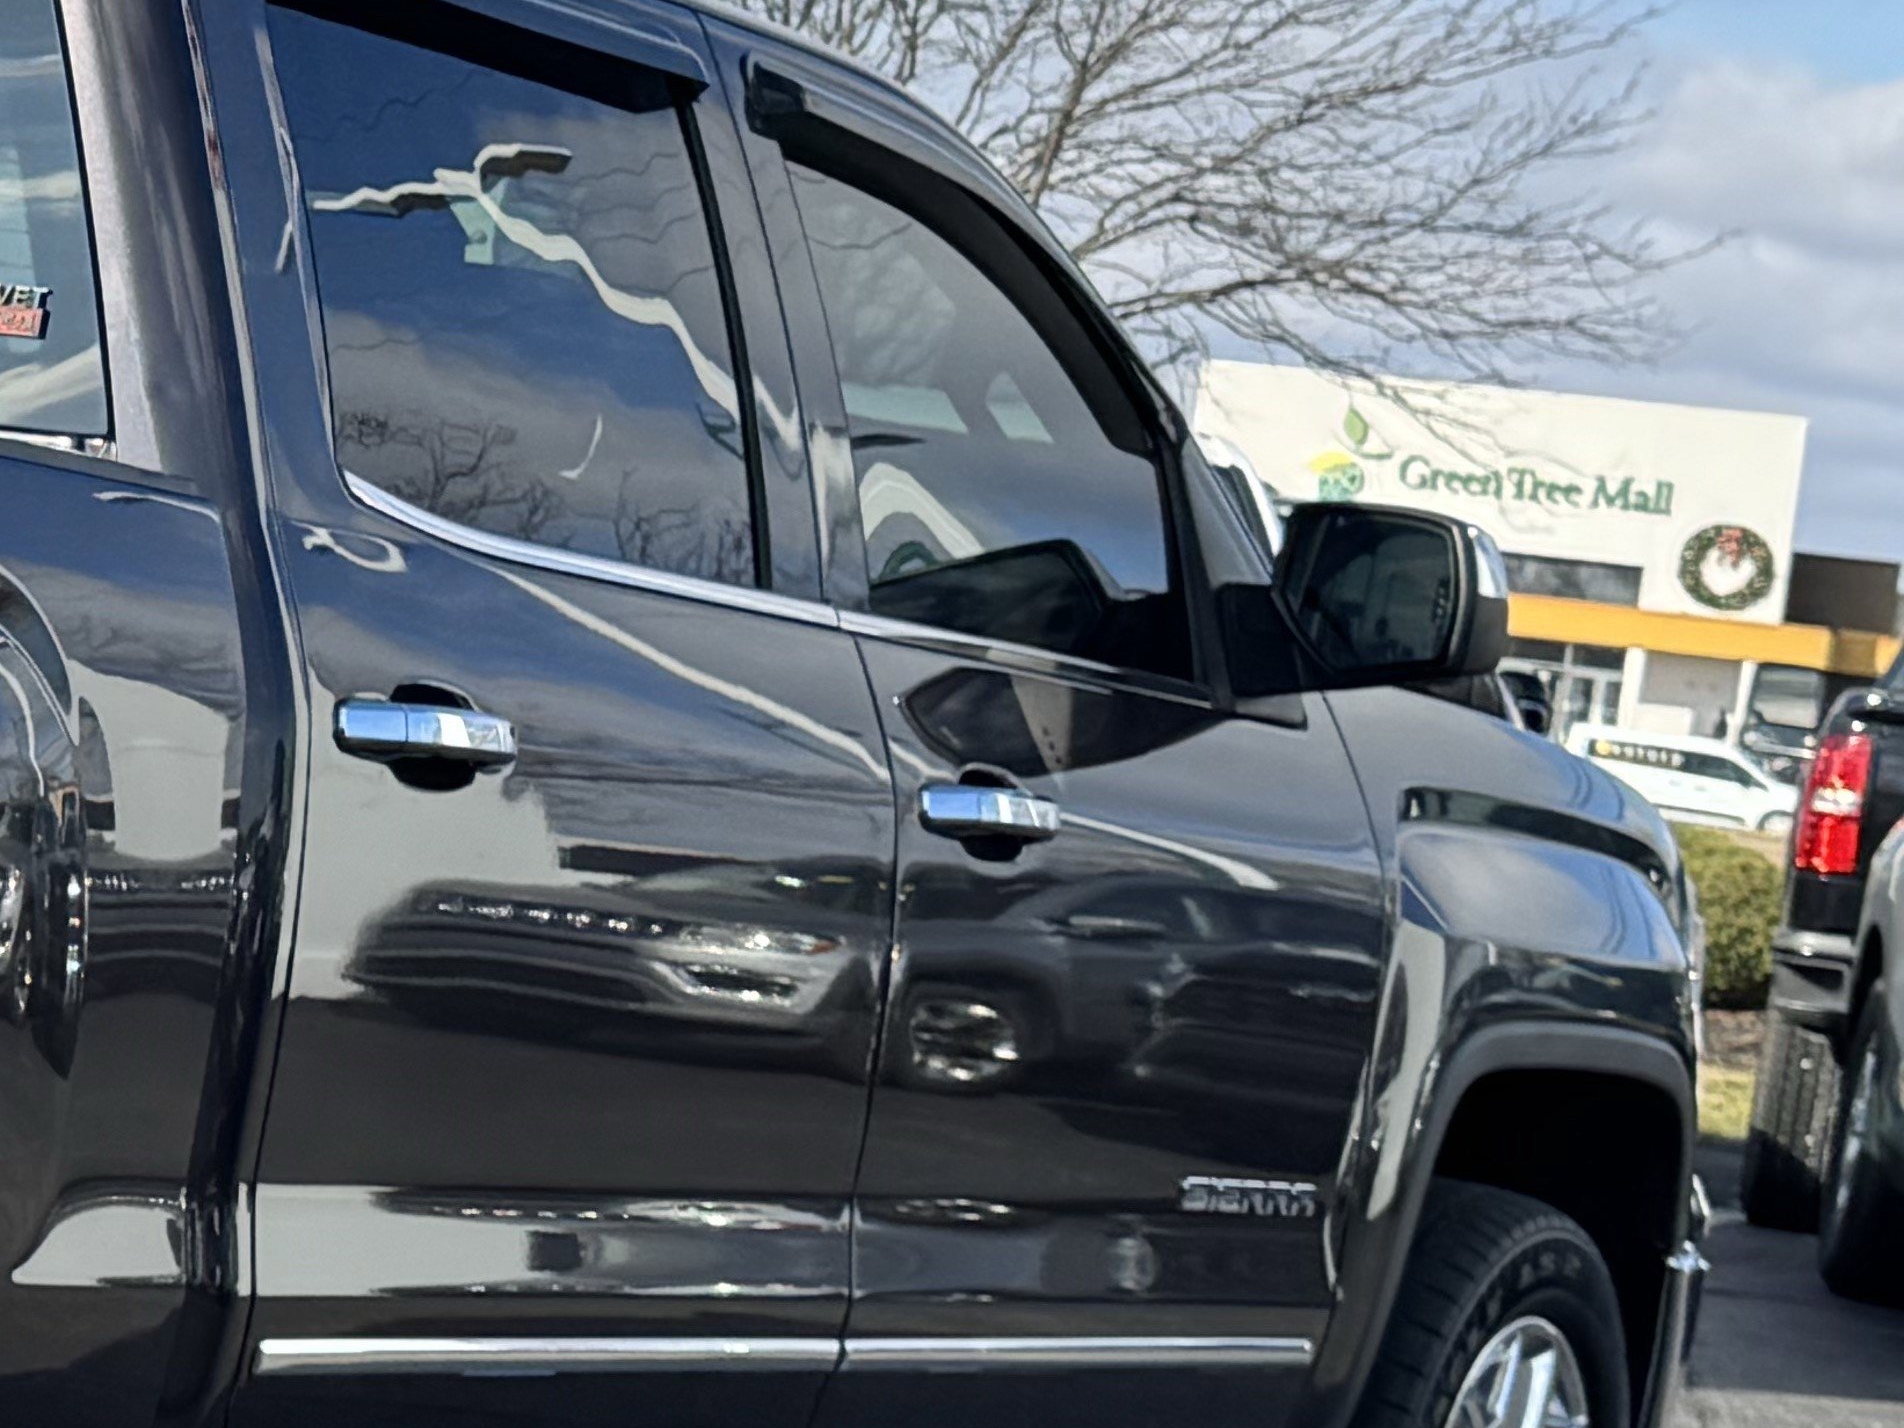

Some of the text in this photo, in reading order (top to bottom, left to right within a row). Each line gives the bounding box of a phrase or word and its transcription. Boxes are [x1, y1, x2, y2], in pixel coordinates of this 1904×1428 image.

[1398, 454, 1675, 516] Green Tree Mall
